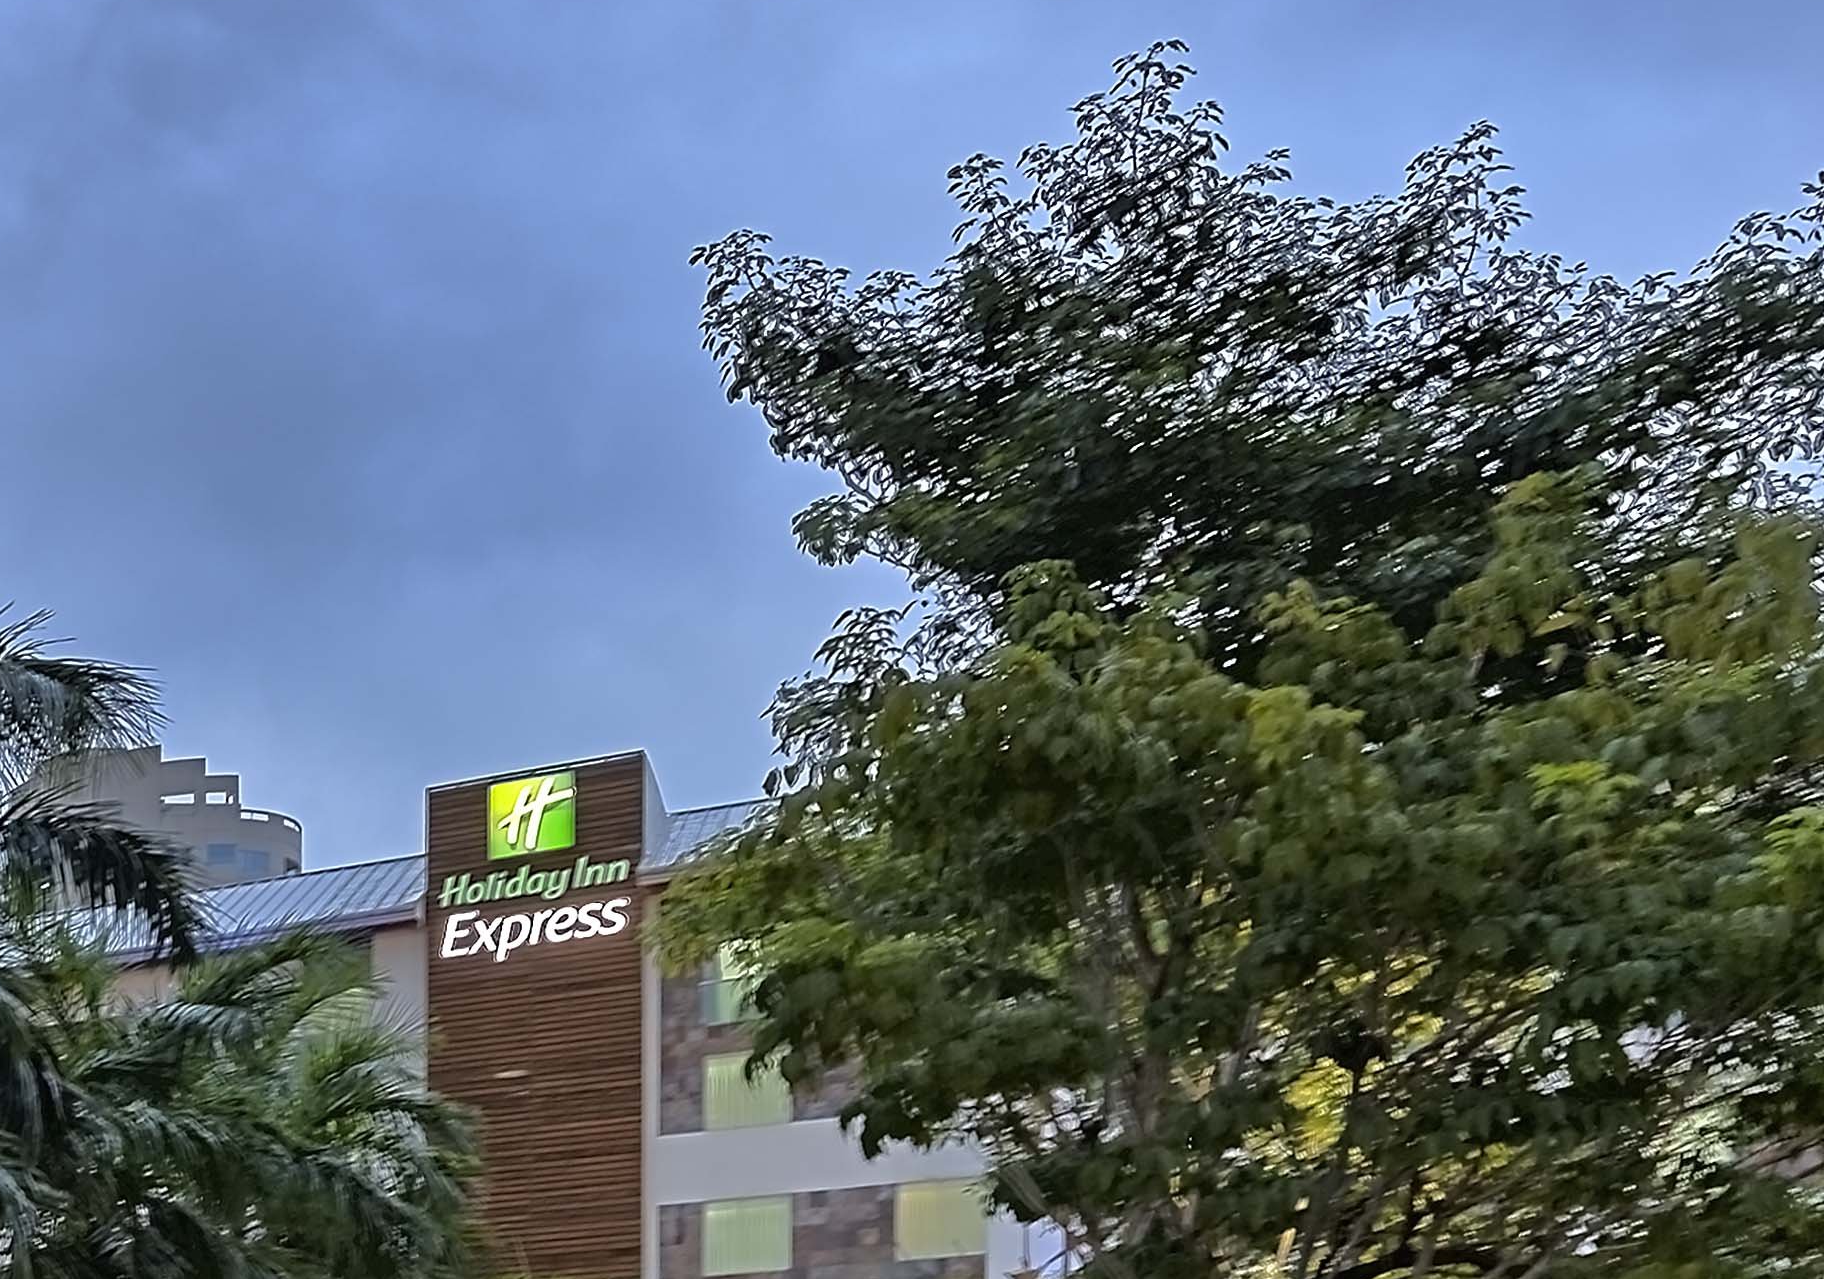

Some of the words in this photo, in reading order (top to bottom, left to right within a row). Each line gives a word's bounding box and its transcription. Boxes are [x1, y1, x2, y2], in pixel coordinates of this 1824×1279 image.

[437, 863, 572, 908] Holiday
[571, 855, 631, 888] Inn
[440, 896, 631, 962] Express
